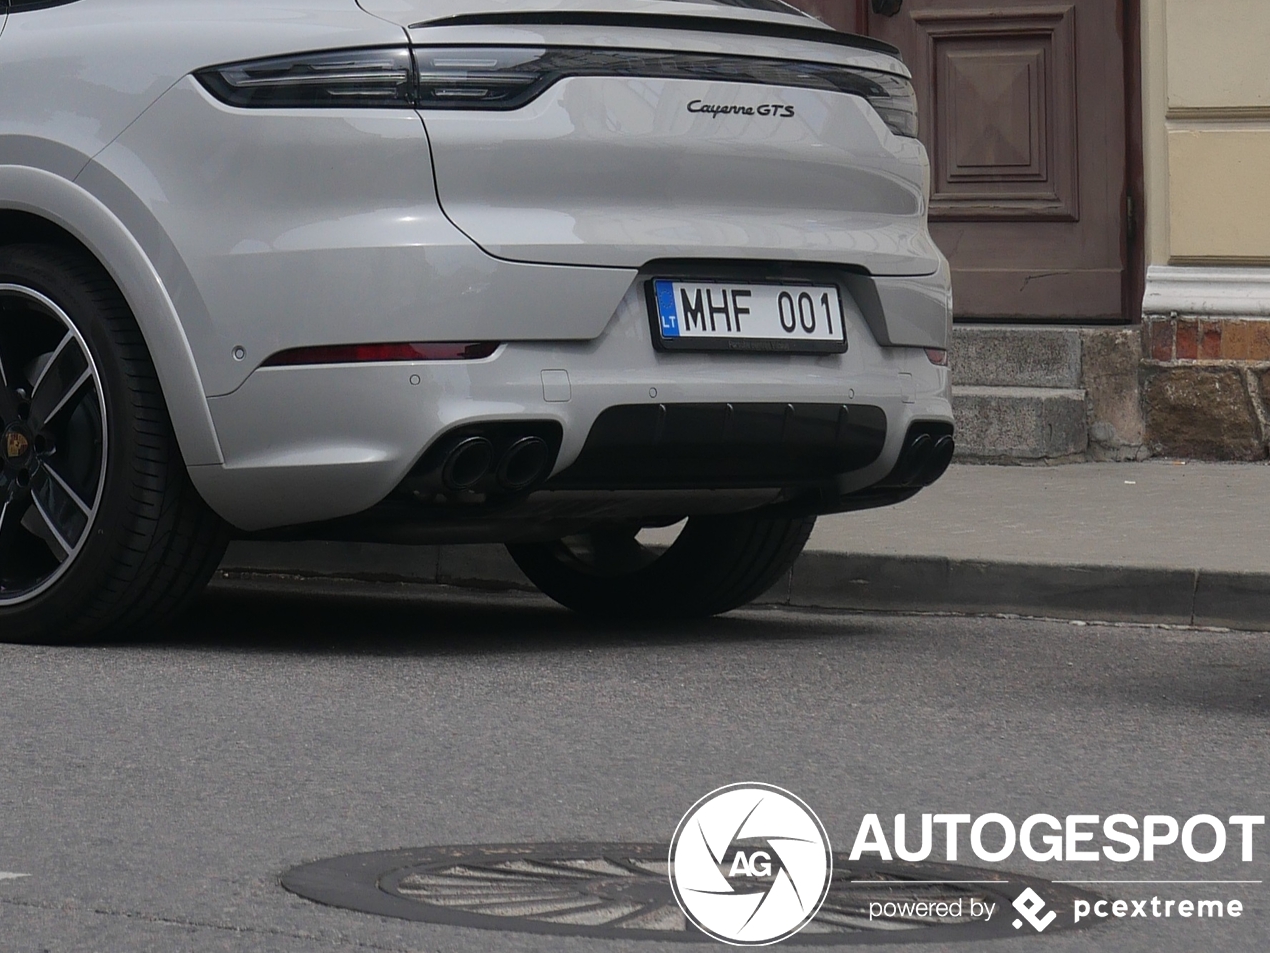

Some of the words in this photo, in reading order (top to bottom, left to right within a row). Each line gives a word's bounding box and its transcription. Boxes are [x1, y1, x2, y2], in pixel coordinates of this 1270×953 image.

[686, 99, 755, 119] Cayenne
[756, 104, 795, 118] GTS
[679, 287, 752, 333] MHF
[777, 290, 834, 335] 001
[661, 316, 676, 329] LT
